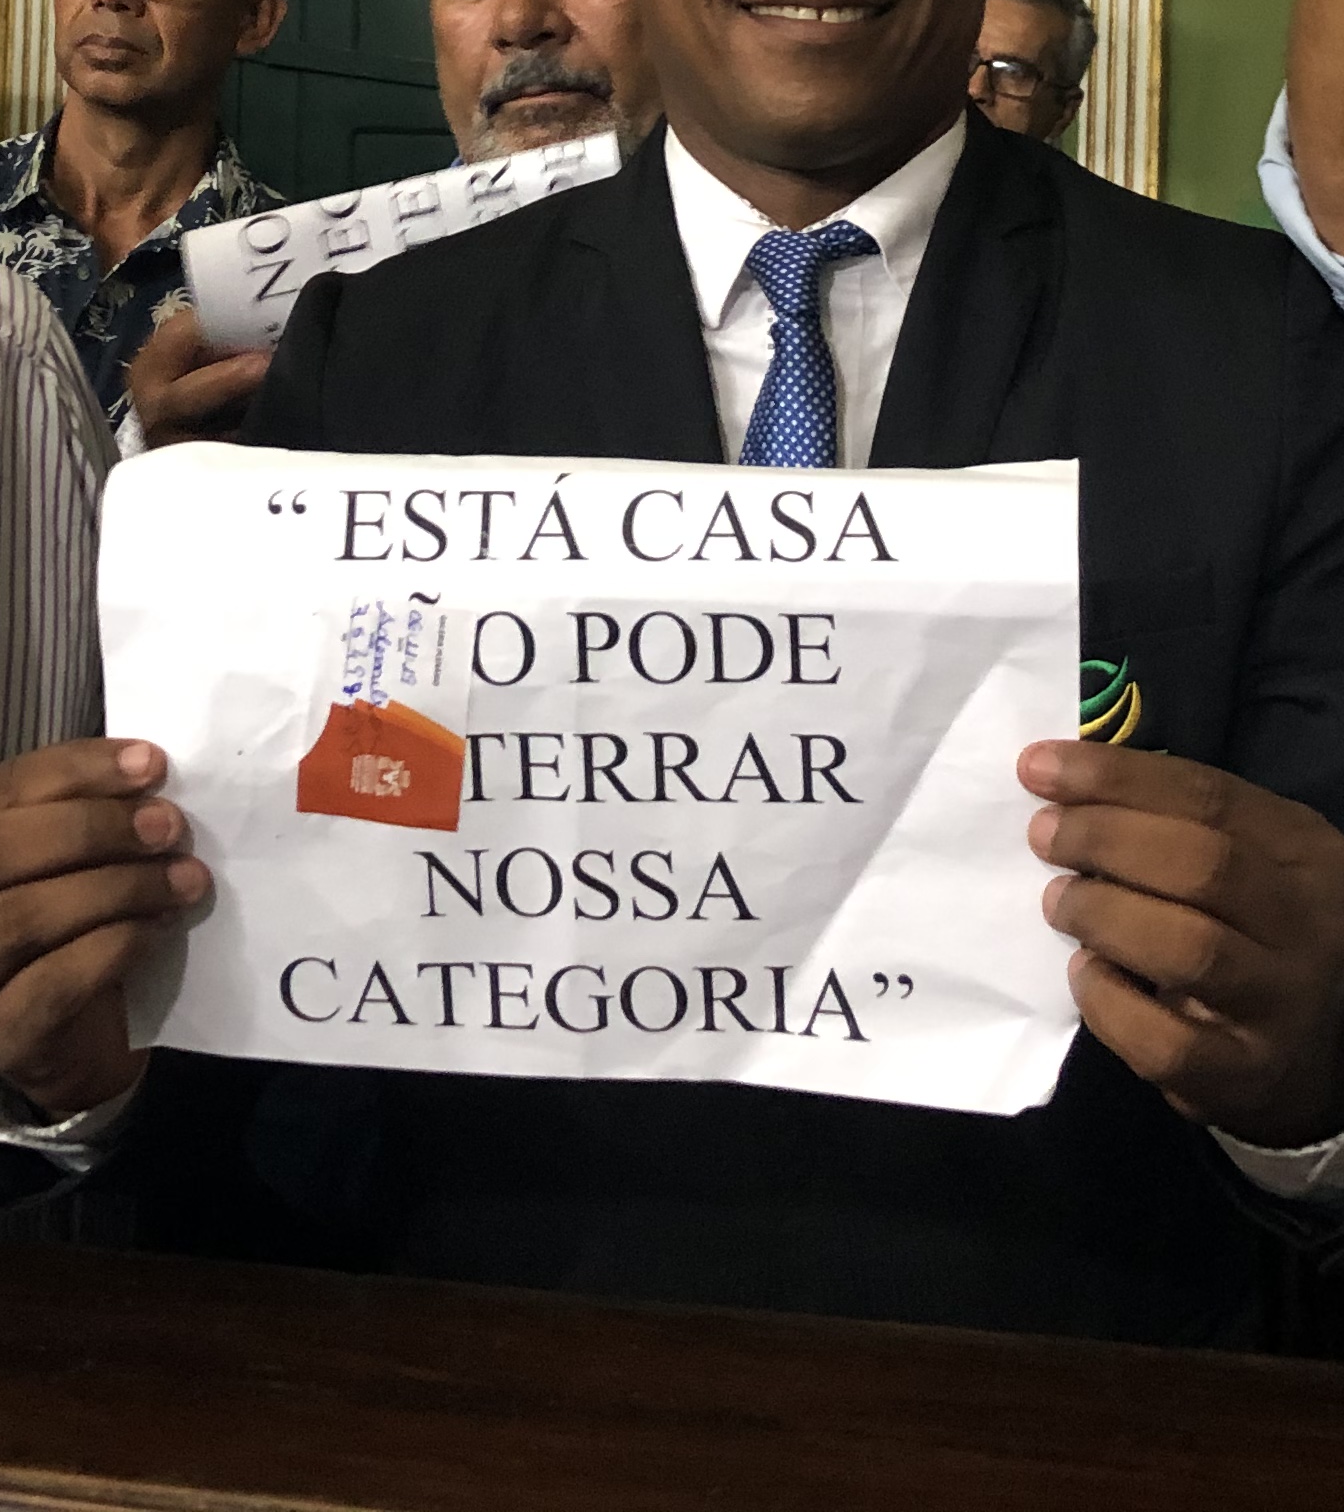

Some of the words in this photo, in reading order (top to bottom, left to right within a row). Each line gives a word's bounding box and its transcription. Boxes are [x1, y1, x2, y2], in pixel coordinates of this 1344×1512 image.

[621, 489, 899, 563] CASA
[566, 610, 842, 686] PODE
[412, 846, 762, 922] NOSSA
